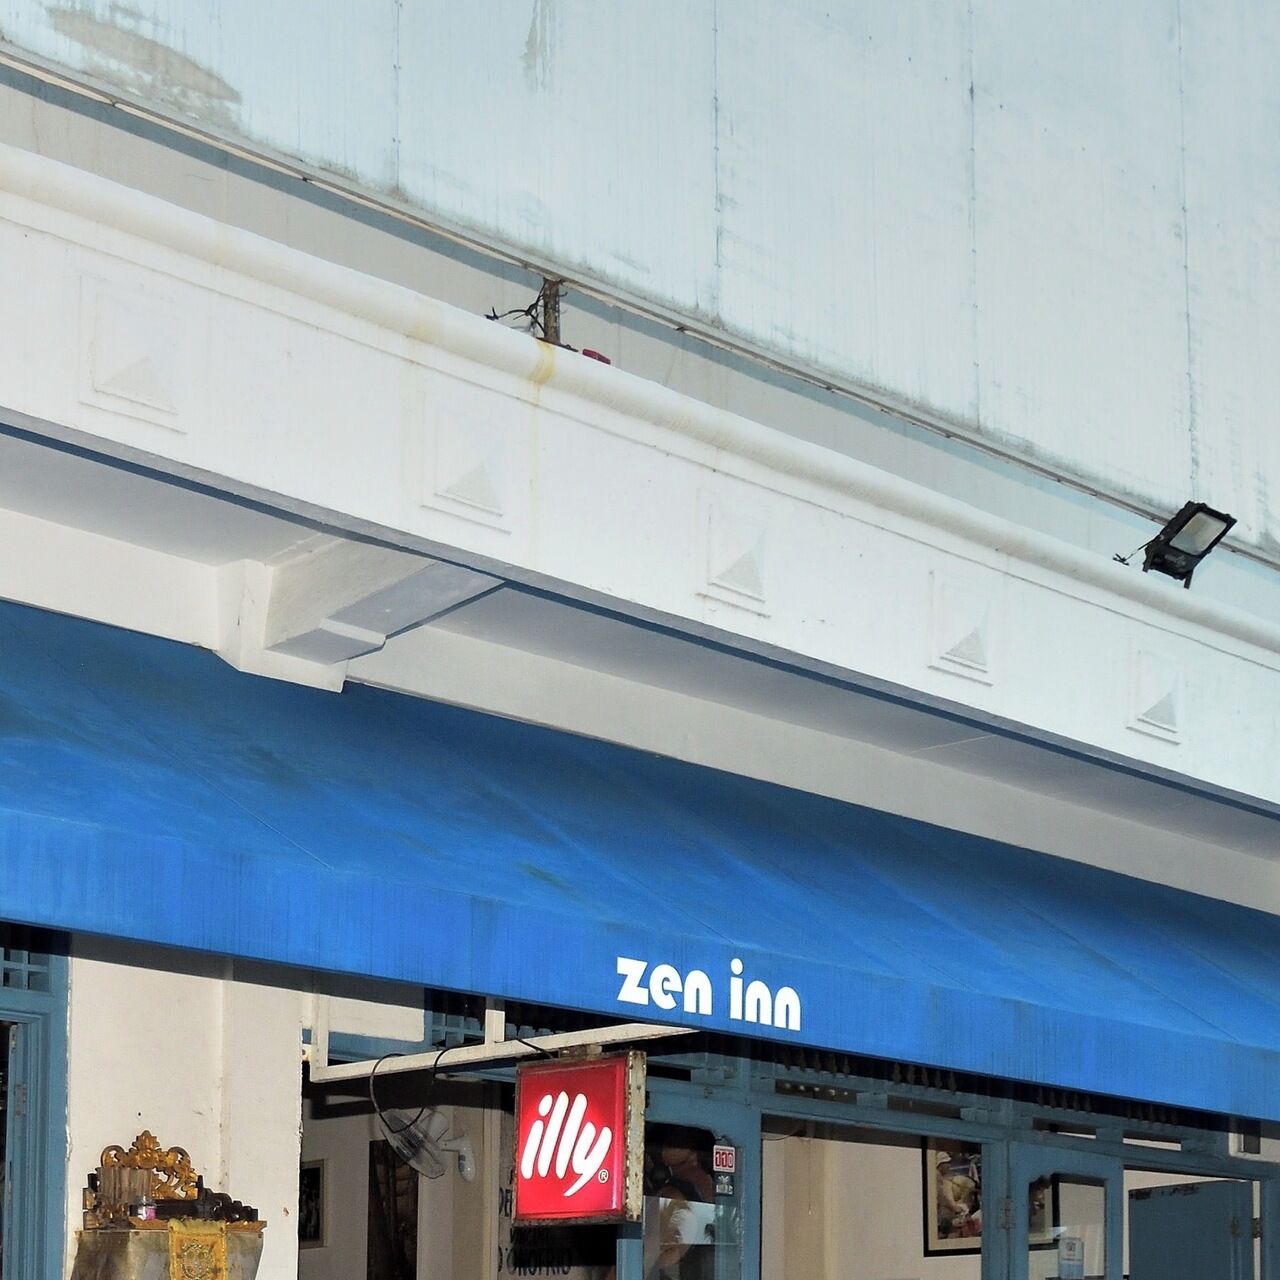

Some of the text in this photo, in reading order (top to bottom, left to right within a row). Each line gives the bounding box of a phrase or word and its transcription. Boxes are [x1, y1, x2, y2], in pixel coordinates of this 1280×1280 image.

[616, 956, 802, 1032] zen inn
[520, 1090, 613, 1198] illy
